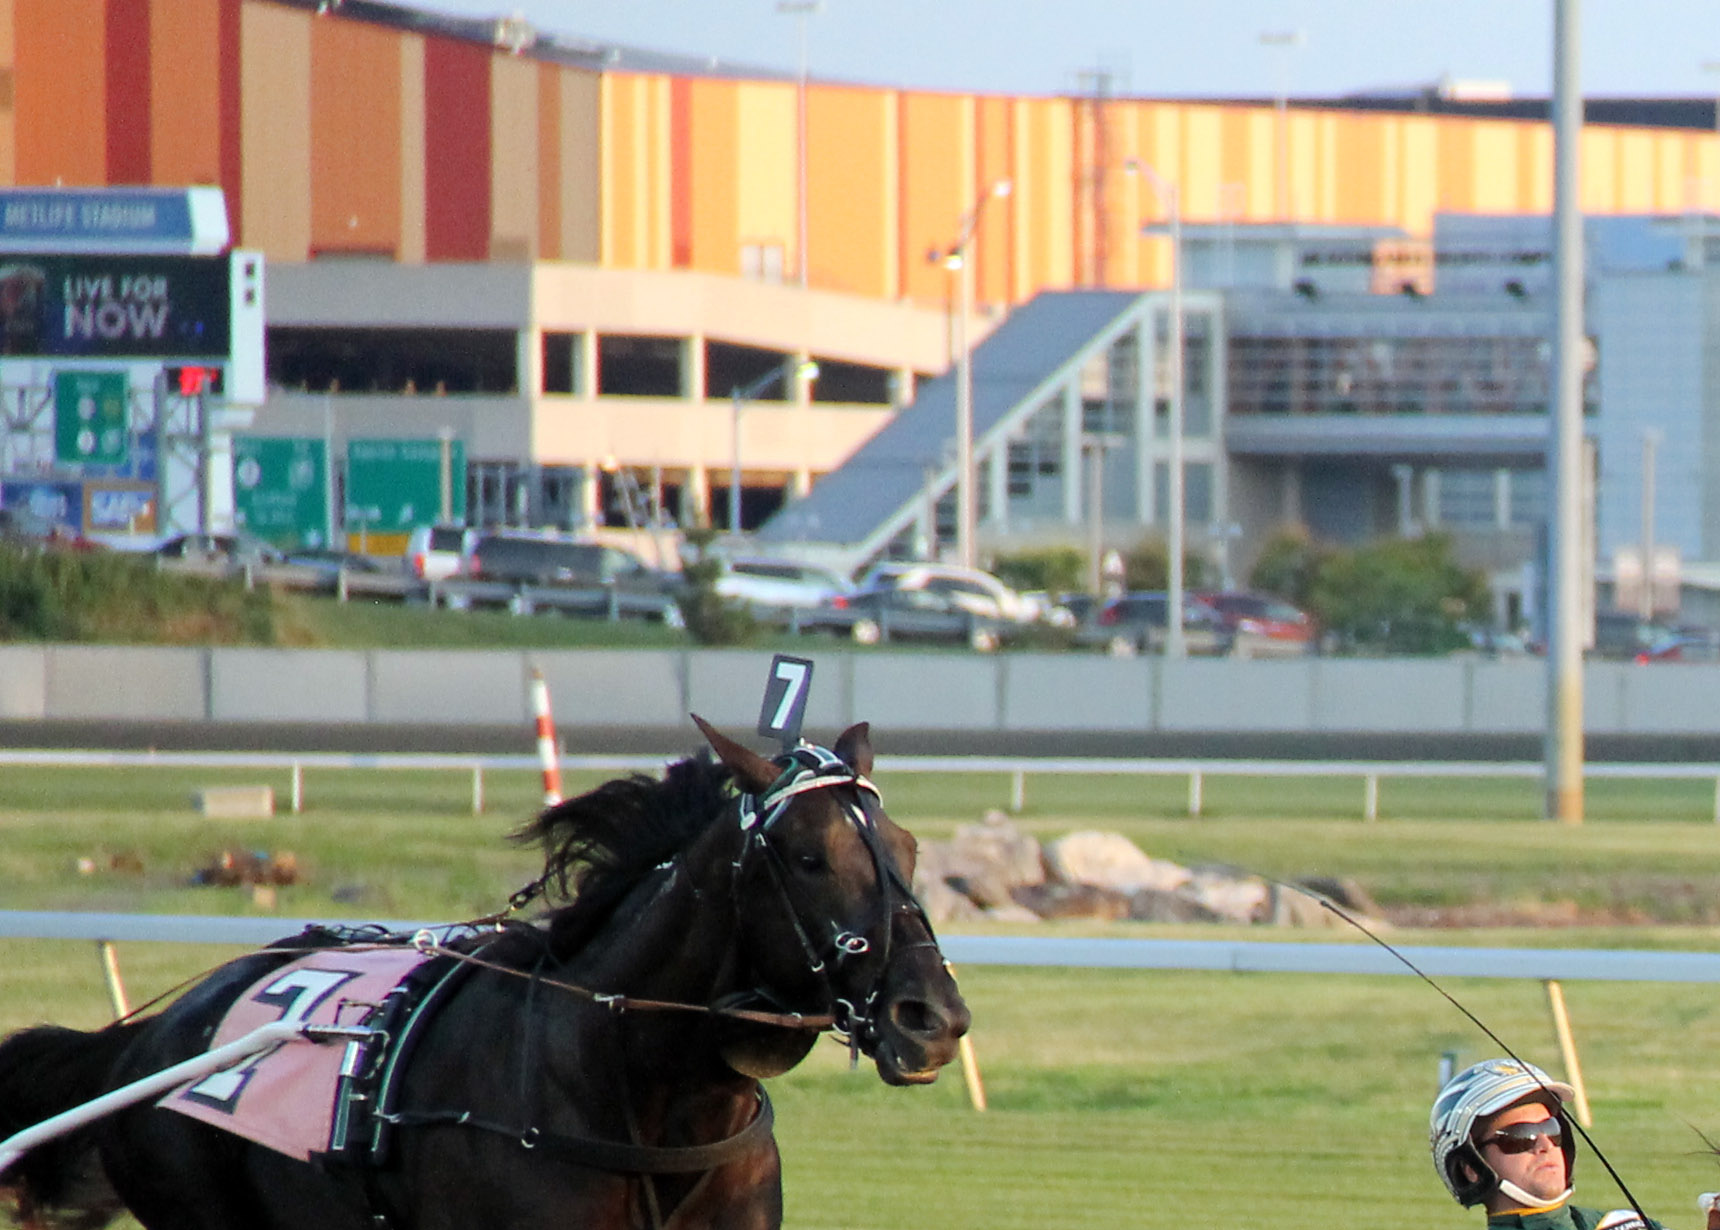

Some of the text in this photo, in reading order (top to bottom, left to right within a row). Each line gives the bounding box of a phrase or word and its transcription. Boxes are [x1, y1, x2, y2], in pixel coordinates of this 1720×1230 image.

[63, 274, 168, 301] LIVE FOR
[63, 301, 169, 339] NOW
[769, 661, 807, 730] 7
[184, 967, 358, 1107] 7
